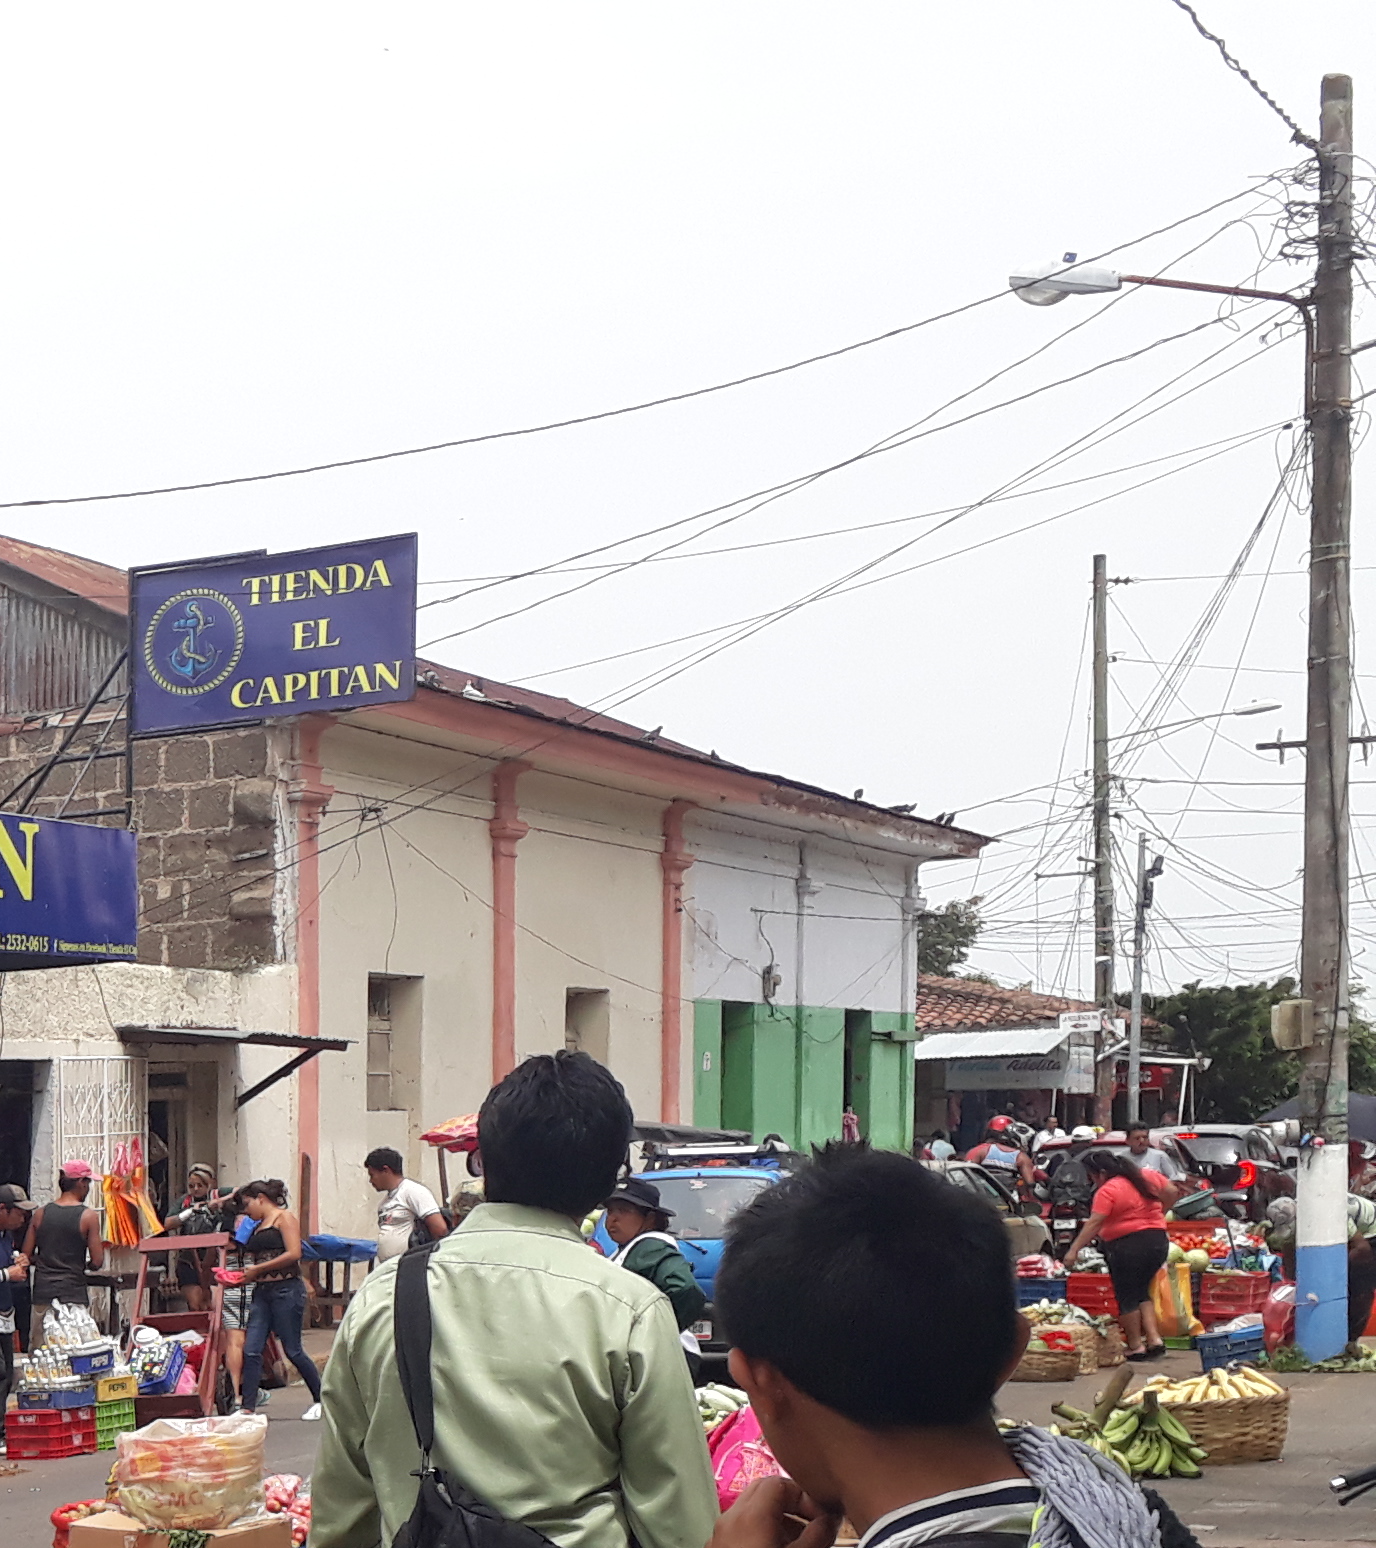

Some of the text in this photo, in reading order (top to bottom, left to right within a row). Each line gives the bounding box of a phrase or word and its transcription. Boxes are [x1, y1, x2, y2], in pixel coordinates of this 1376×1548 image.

[242, 559, 392, 606] TIENDA
[292, 617, 341, 651] EL
[230, 660, 403, 709] CAPITAN
